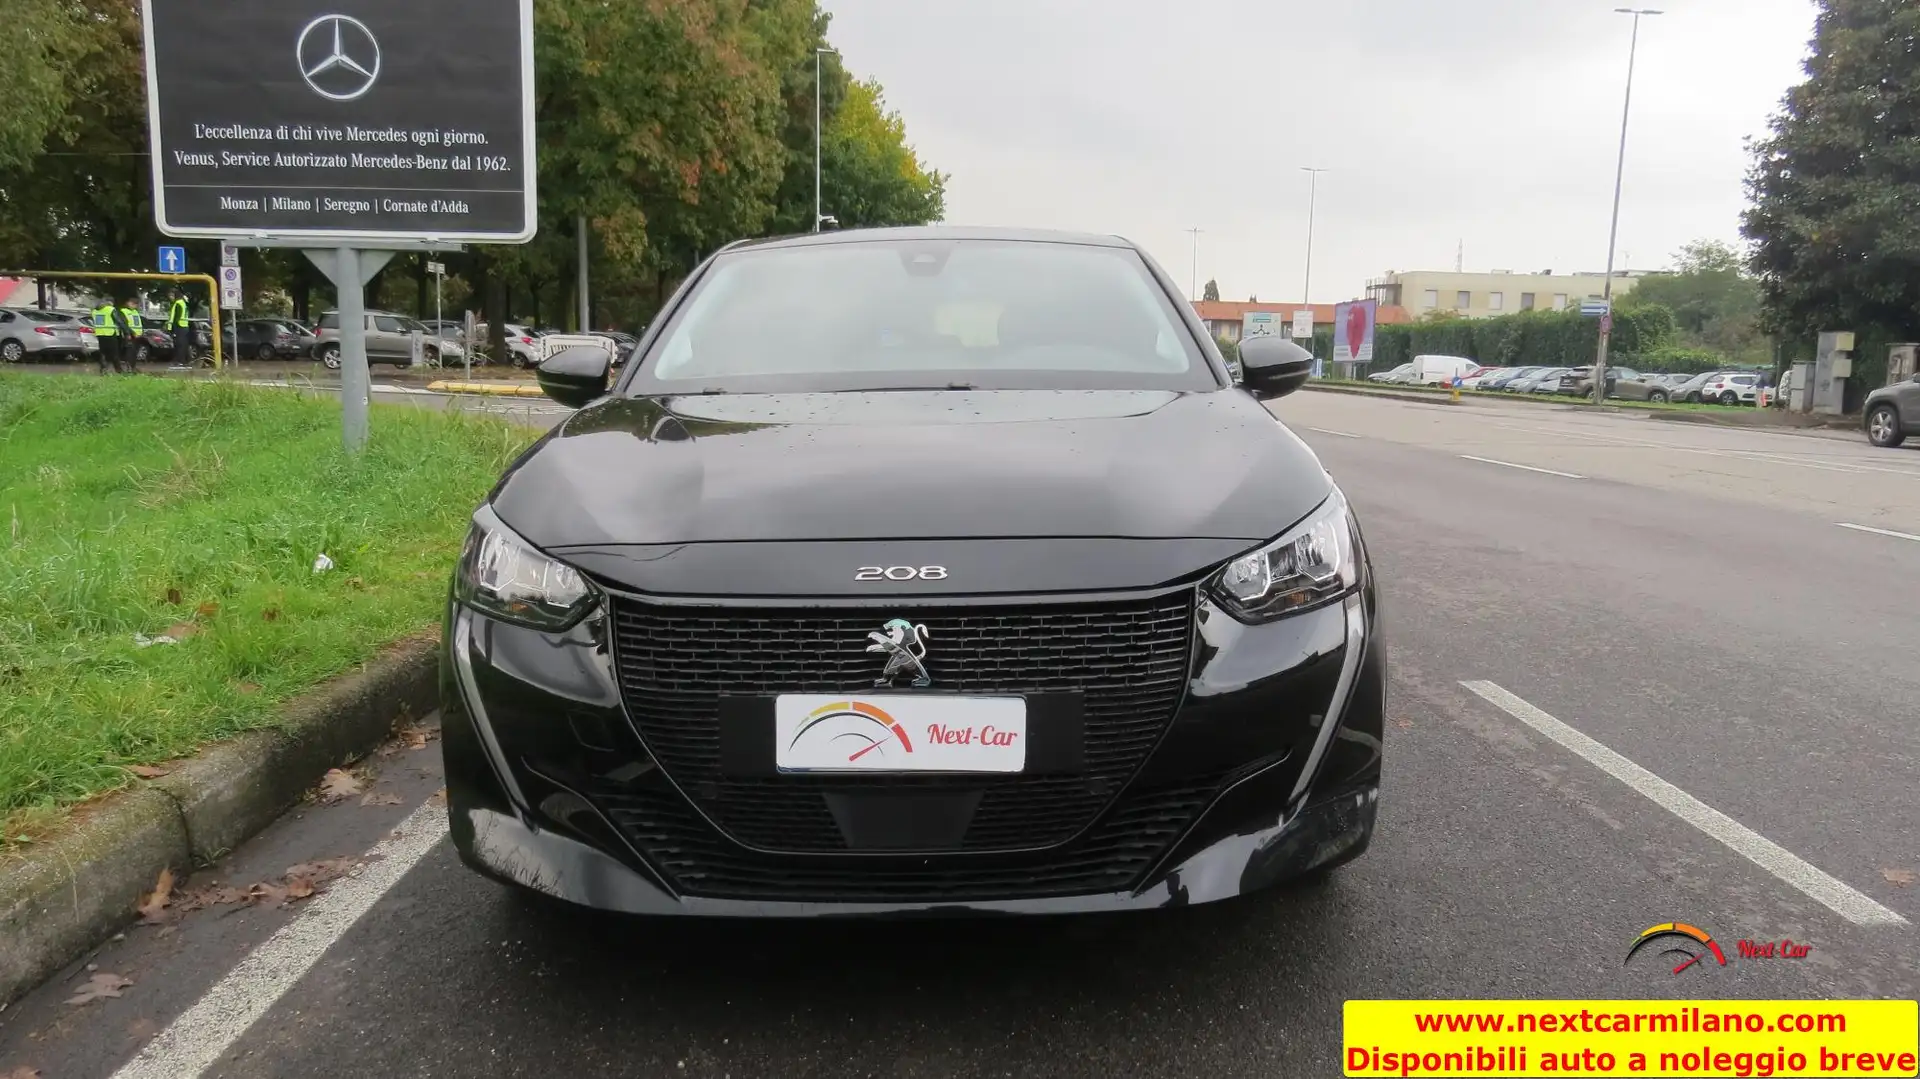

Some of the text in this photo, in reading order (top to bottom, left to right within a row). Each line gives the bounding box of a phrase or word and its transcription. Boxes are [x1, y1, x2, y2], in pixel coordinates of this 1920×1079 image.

[194, 123, 489, 147] L'eccellenza di chi vive Mercedes ogni giorno.
[173, 150, 511, 171] Venus, Service Autorizzato Mercedes-Benz dal 1962.
[220, 196, 469, 214] Monza Milano Seregno Cornate d'Adda
[854, 565, 949, 581] 208
[927, 723, 1018, 747] Next-Car
